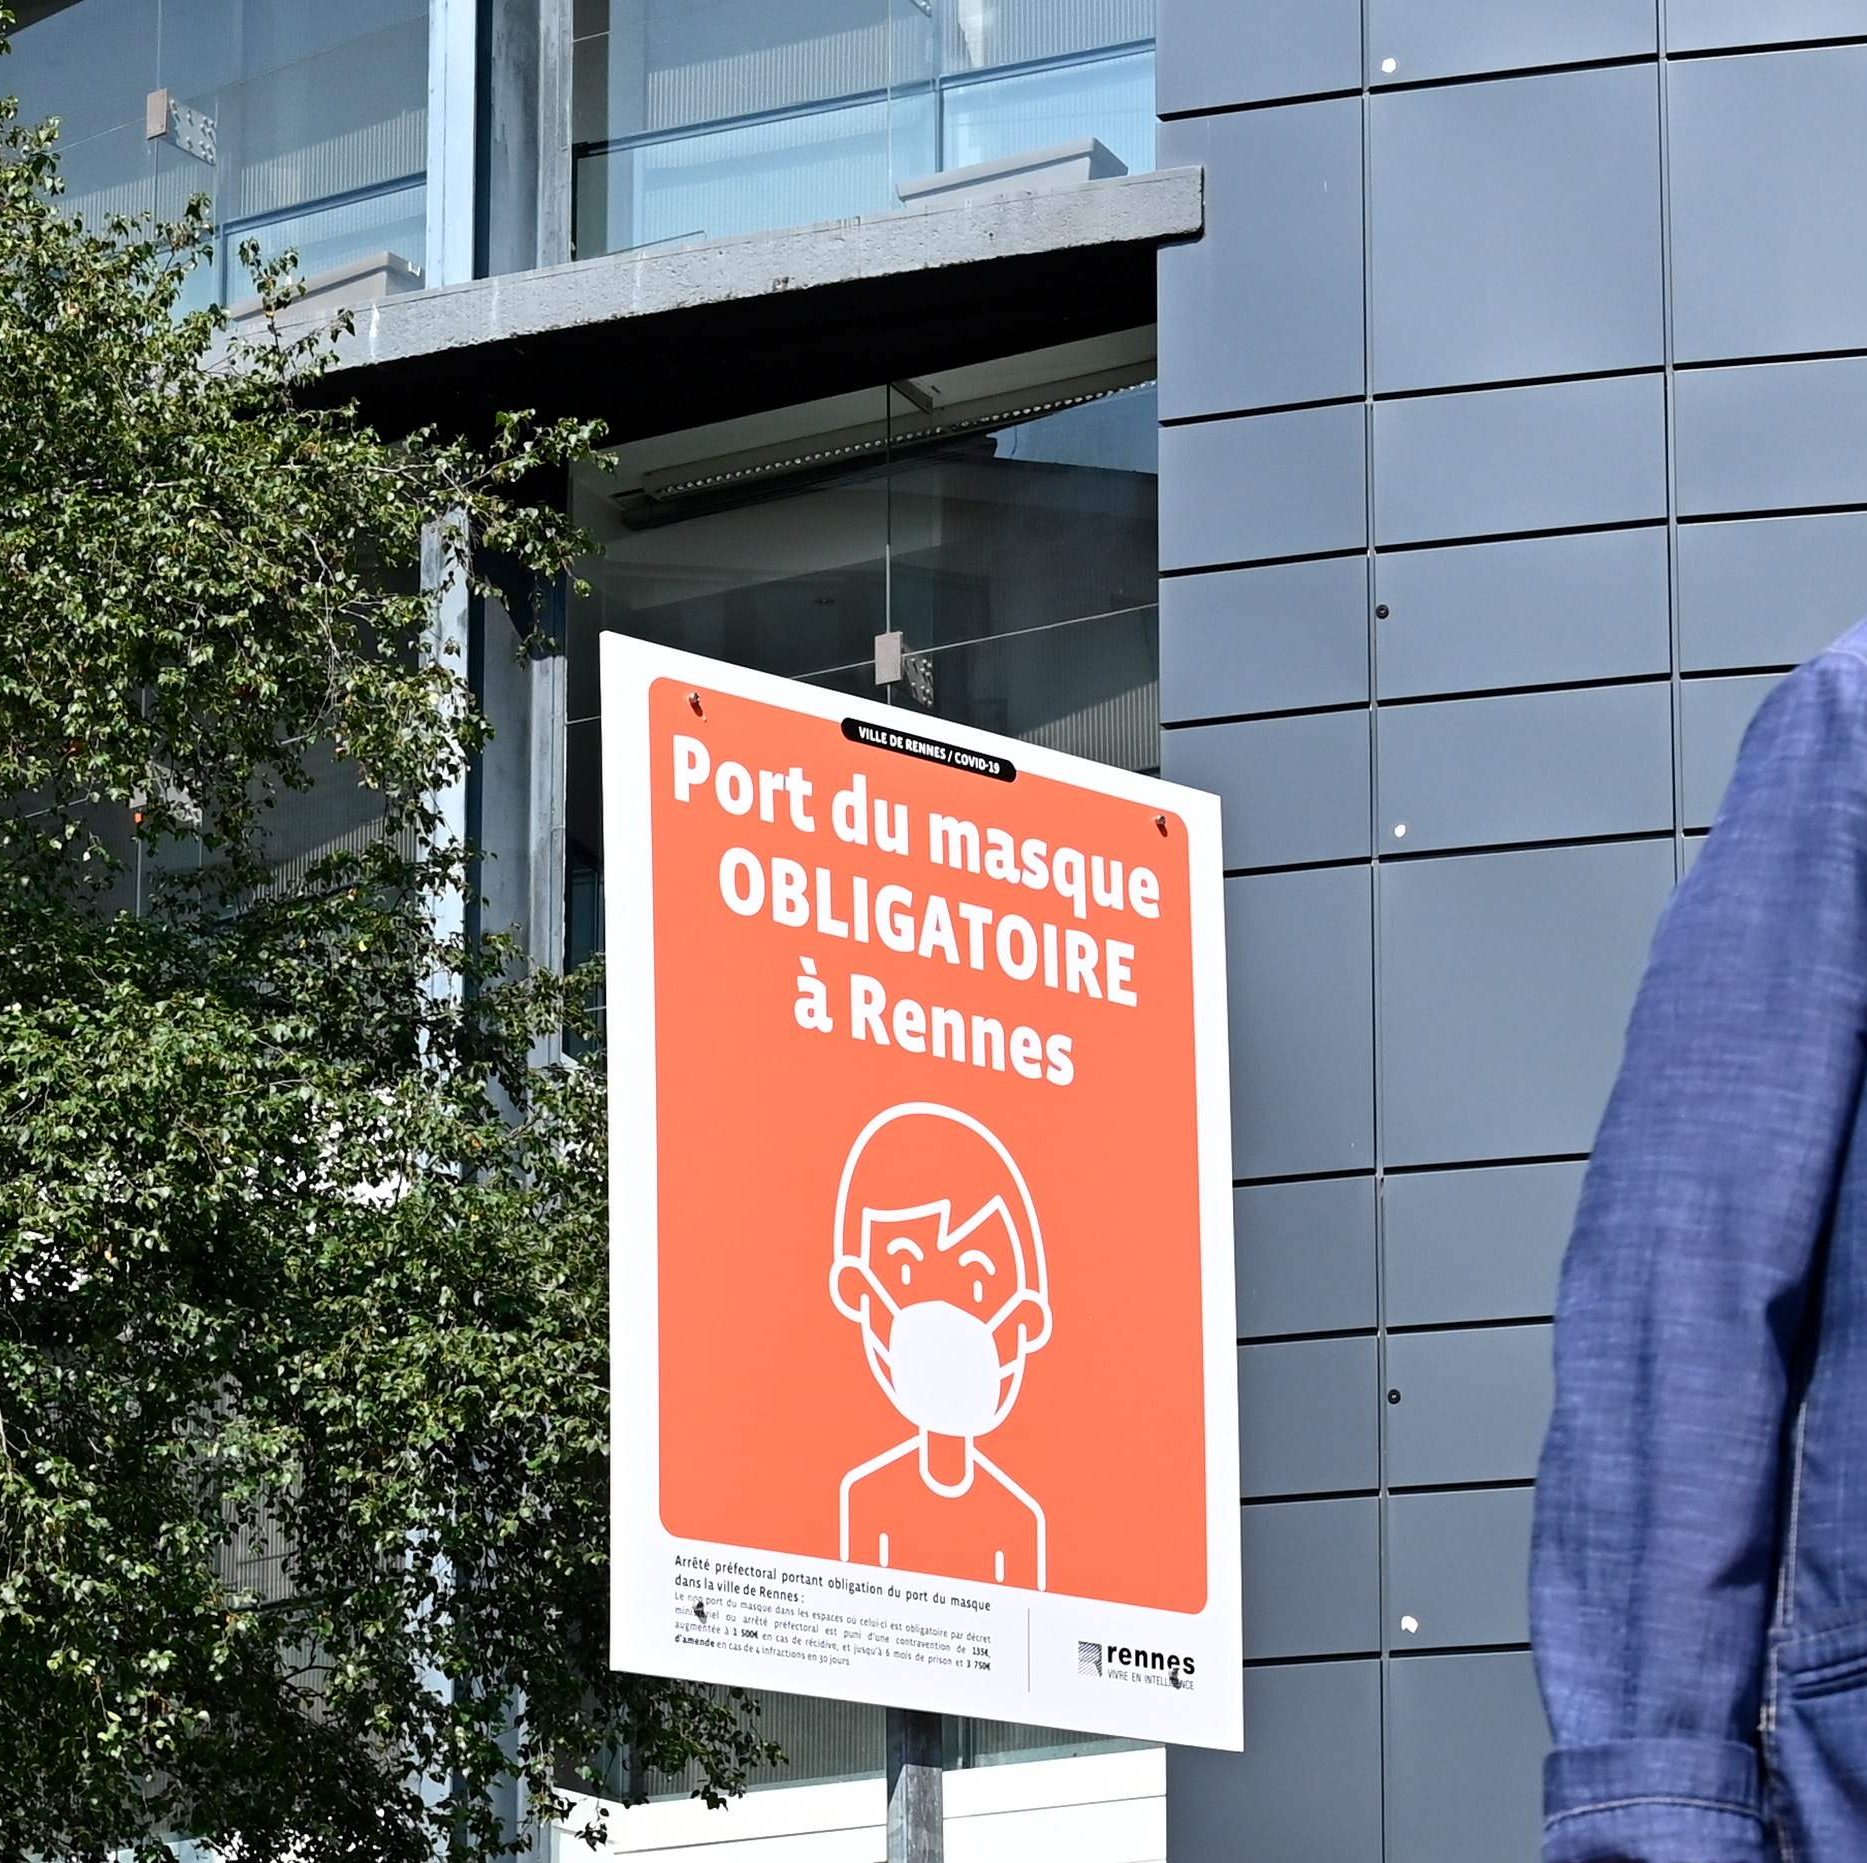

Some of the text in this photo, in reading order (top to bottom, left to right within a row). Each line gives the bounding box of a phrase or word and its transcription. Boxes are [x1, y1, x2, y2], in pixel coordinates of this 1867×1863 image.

[858, 726, 888, 745] VILLE
[889, 734, 903, 749] DE
[905, 738, 946, 761] RENNES
[954, 752, 1000, 775] COVID-19
[673, 734, 1161, 919] Port du masque
[719, 846, 1137, 1008] OBLIGATOIRE
[794, 956, 1075, 1086] à Rennes
[675, 1555, 991, 1612] Arrêté préfectoral portant obligation du port du masque
[675, 1574, 701, 1589] dans
[704, 1577, 714, 1591] la
[717, 1580, 740, 1594] ville
[743, 1584, 756, 1596] de
[760, 1586, 799, 1602] Rennes
[675, 1591, 684, 1601] Le
[706, 1596, 723, 1606] port
[727, 1598, 737, 1608] du
[740, 1601, 772, 1614] masque
[775, 1605, 794, 1616] dans
[798, 1608, 809, 1618] les
[812, 1610, 843, 1623] espaces
[890, 1621, 902, 1631] est
[906, 1623, 948, 1637] obligatoire
[951, 1630, 963, 1640] par
[966, 1630, 991, 1644] décret
[774, 1620, 819, 1633] préfectoral
[825, 1627, 838, 1637] est
[843, 1629, 862, 1640] puni
[896, 1637, 951, 1651] contravention
[956, 1644, 966, 1654] de
[675, 1620, 721, 1635] augmentée
[762, 1633, 772, 1641] en
[775, 1634, 789, 1644] cas
[792, 1636, 802, 1646] de
[842, 1642, 851, 1652] et
[894, 1650, 912, 1660] mois
[915, 1652, 924, 1662] de
[928, 1653, 952, 1665] prison
[955, 1658, 964, 1667] et
[675, 1634, 715, 1648] d'amende
[717, 1640, 727, 1649] en
[729, 1642, 742, 1652] cas
[743, 1644, 753, 1653] de
[762, 1646, 805, 1660] infractions
[808, 1652, 817, 1661] en
[1107, 1645, 1195, 1675] rennes
[1107, 1669, 1128, 1681] VIVRE
[1132, 1672, 1141, 1683] EN
